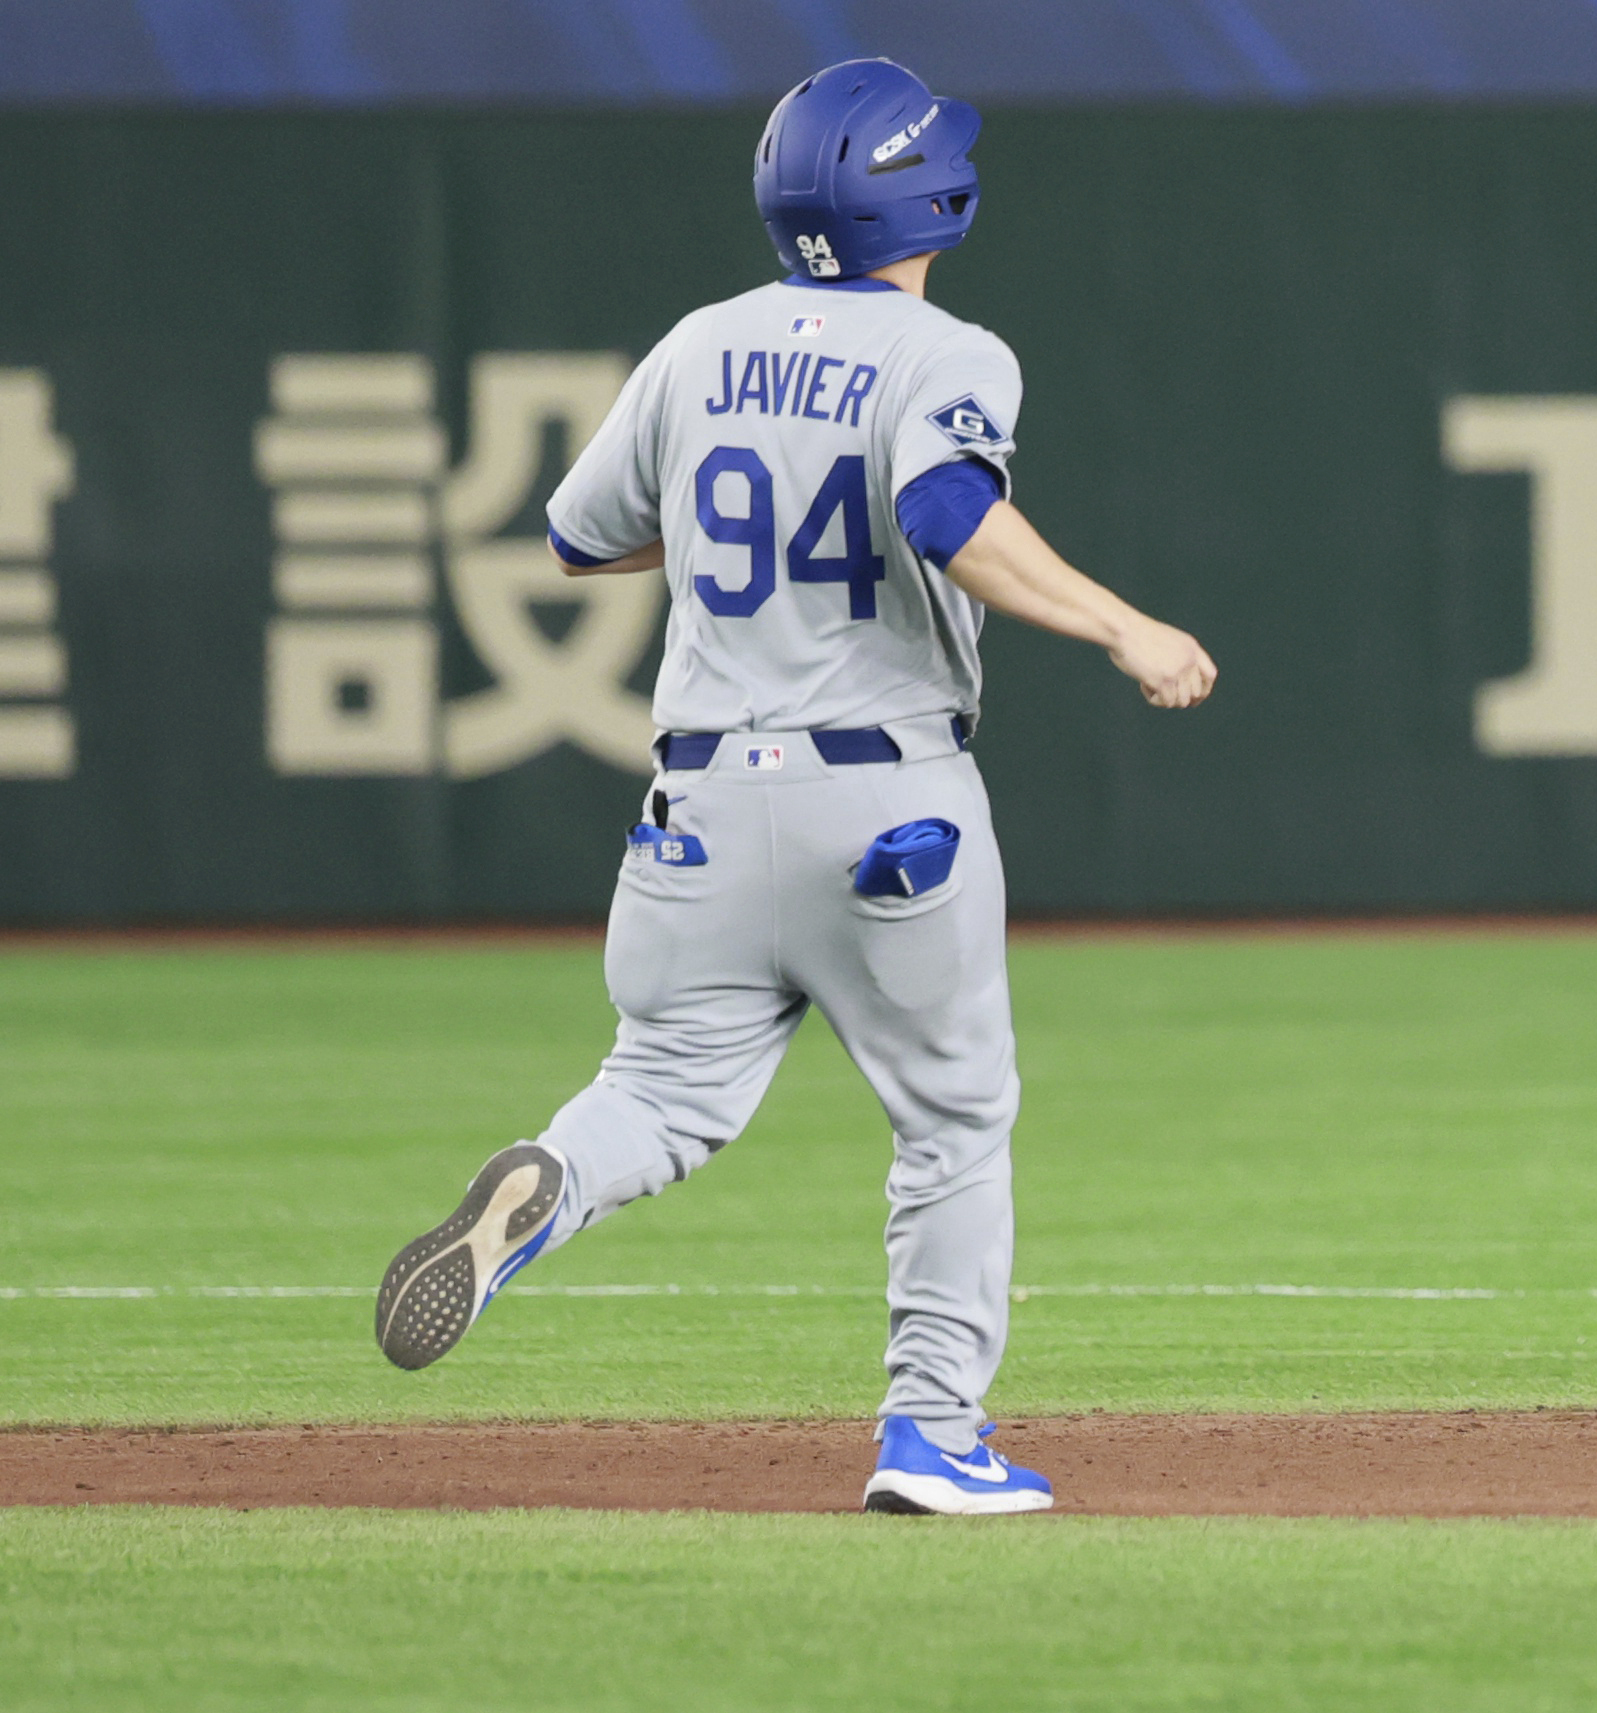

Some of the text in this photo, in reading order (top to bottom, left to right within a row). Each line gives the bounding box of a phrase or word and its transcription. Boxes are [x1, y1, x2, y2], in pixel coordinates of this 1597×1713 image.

[796, 233, 833, 260] 94
[705, 349, 878, 429] JAVIER
[0, 351, 670, 780] 設
[693, 446, 887, 620] 94
